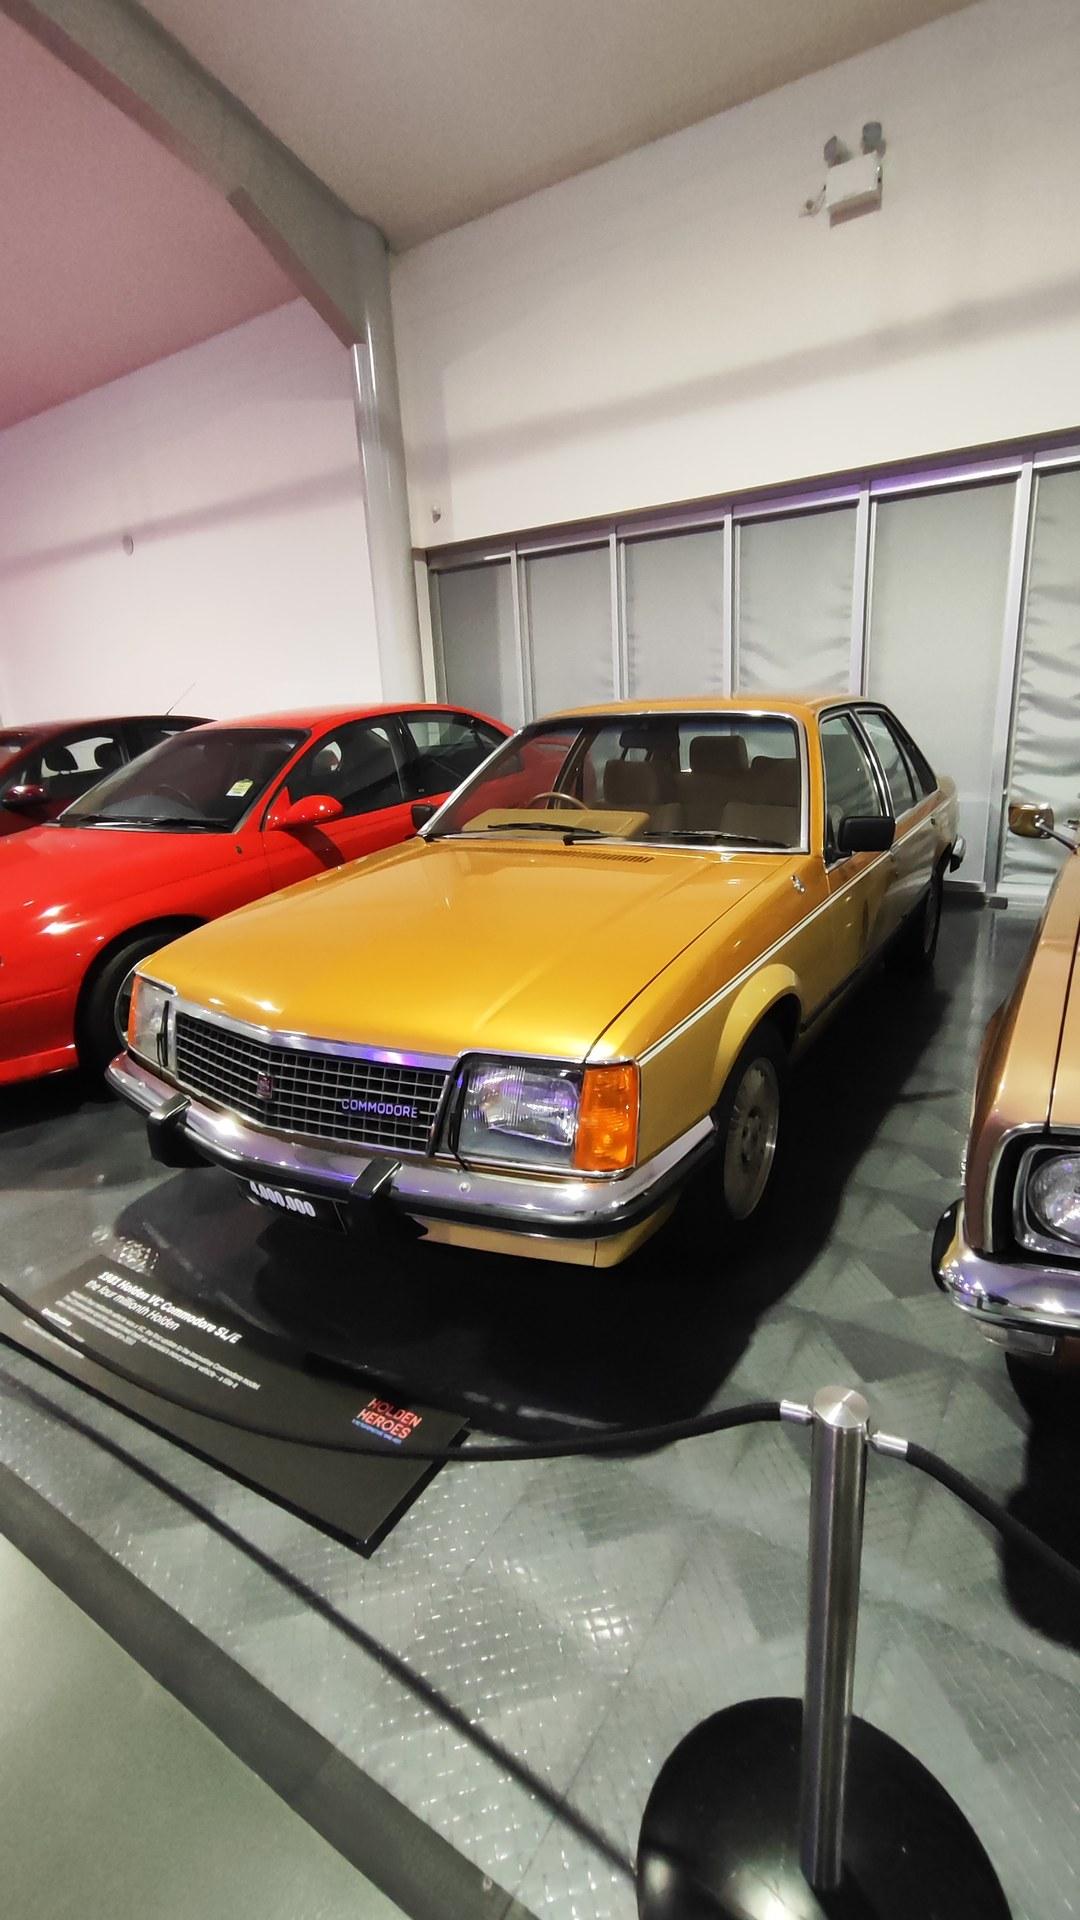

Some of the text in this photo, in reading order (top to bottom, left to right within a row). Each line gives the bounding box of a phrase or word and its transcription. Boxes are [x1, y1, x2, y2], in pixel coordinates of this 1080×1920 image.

[341, 1098, 418, 1119] COMMODORE
[113, 1294, 151, 1316] millionth
[146, 1309, 181, 1331] Holden
[117, 1280, 151, 1300] Holden
[147, 1294, 166, 1307] VC
[160, 1301, 217, 1332] Commodore
[213, 1326, 243, 1344] SL/E
[356, 1408, 412, 1439] HEROES
[367, 1397, 423, 1428] HOLDEN
